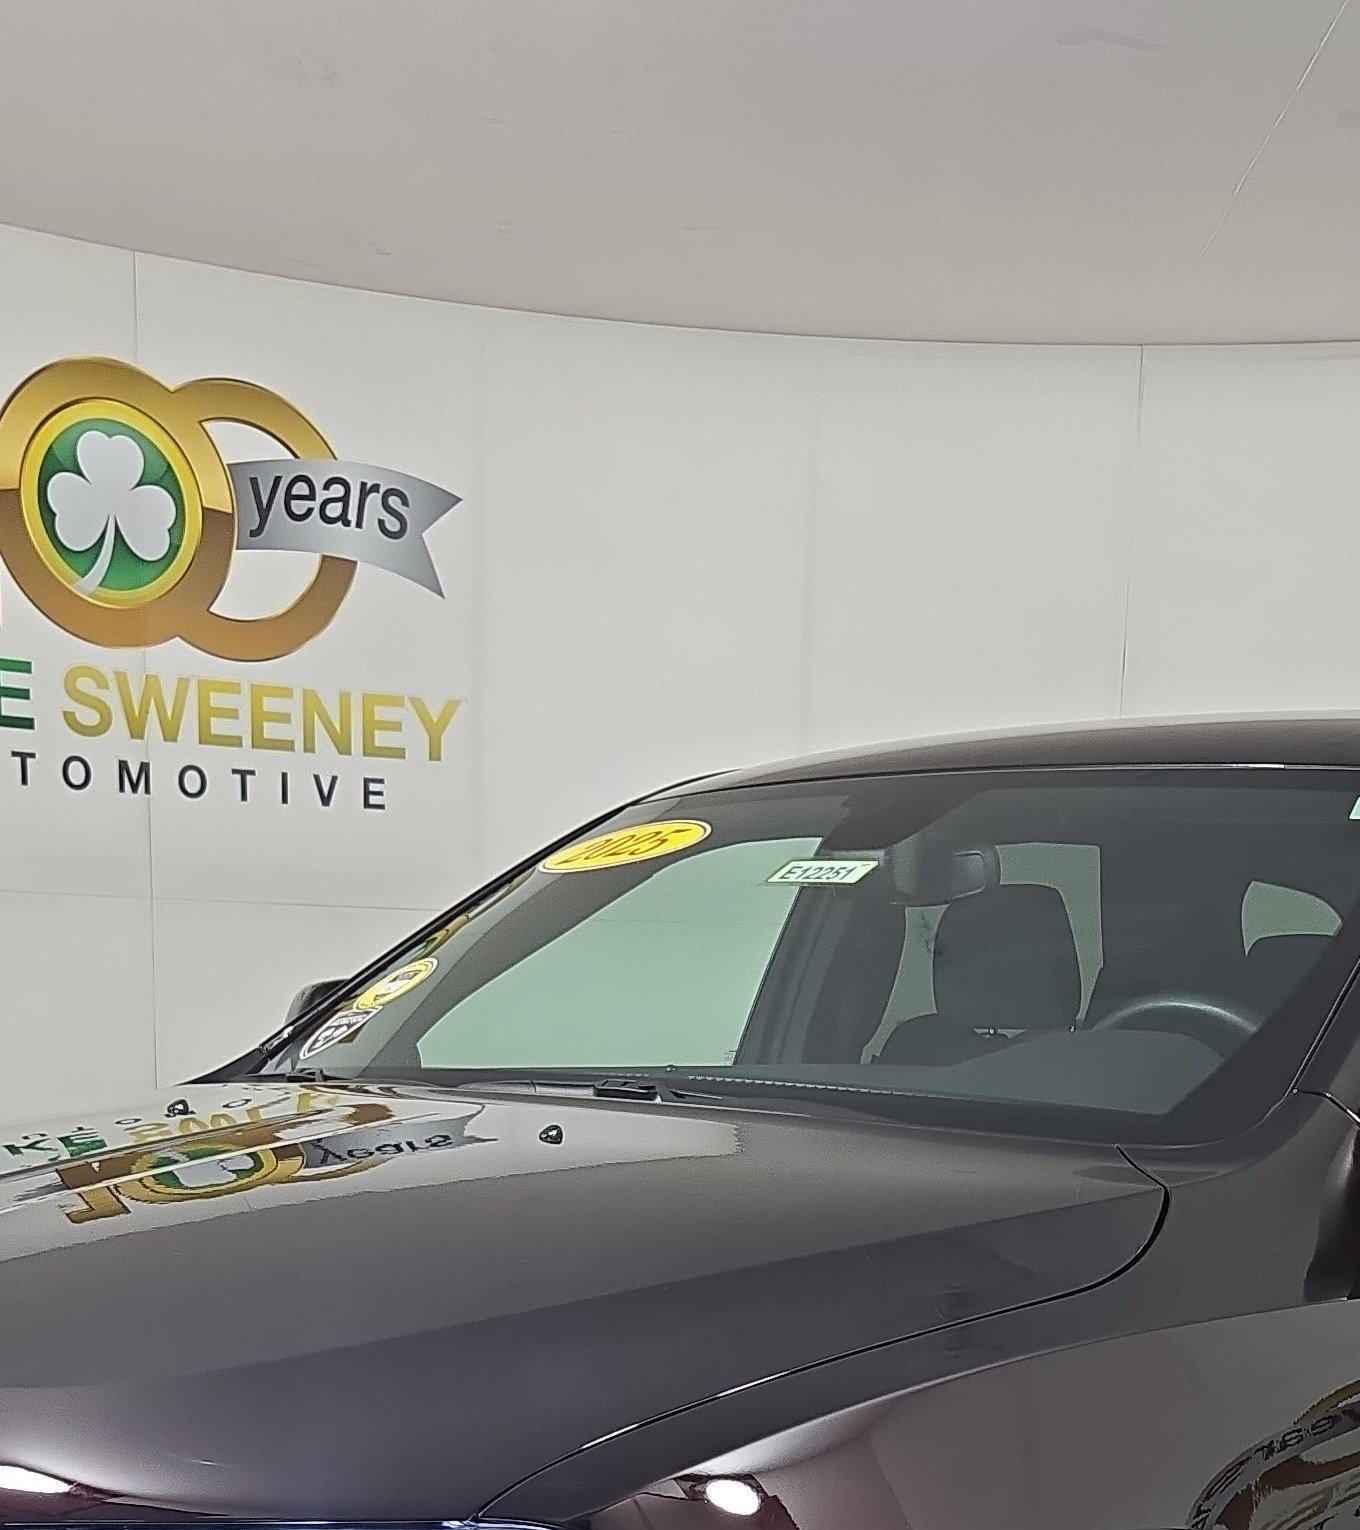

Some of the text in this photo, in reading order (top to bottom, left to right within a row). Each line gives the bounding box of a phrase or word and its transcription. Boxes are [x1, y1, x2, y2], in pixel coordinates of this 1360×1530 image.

[248, 469, 411, 540] years
[62, 665, 462, 762] SWEENEY
[554, 828, 693, 866] 2025
[779, 864, 858, 881] E12251
